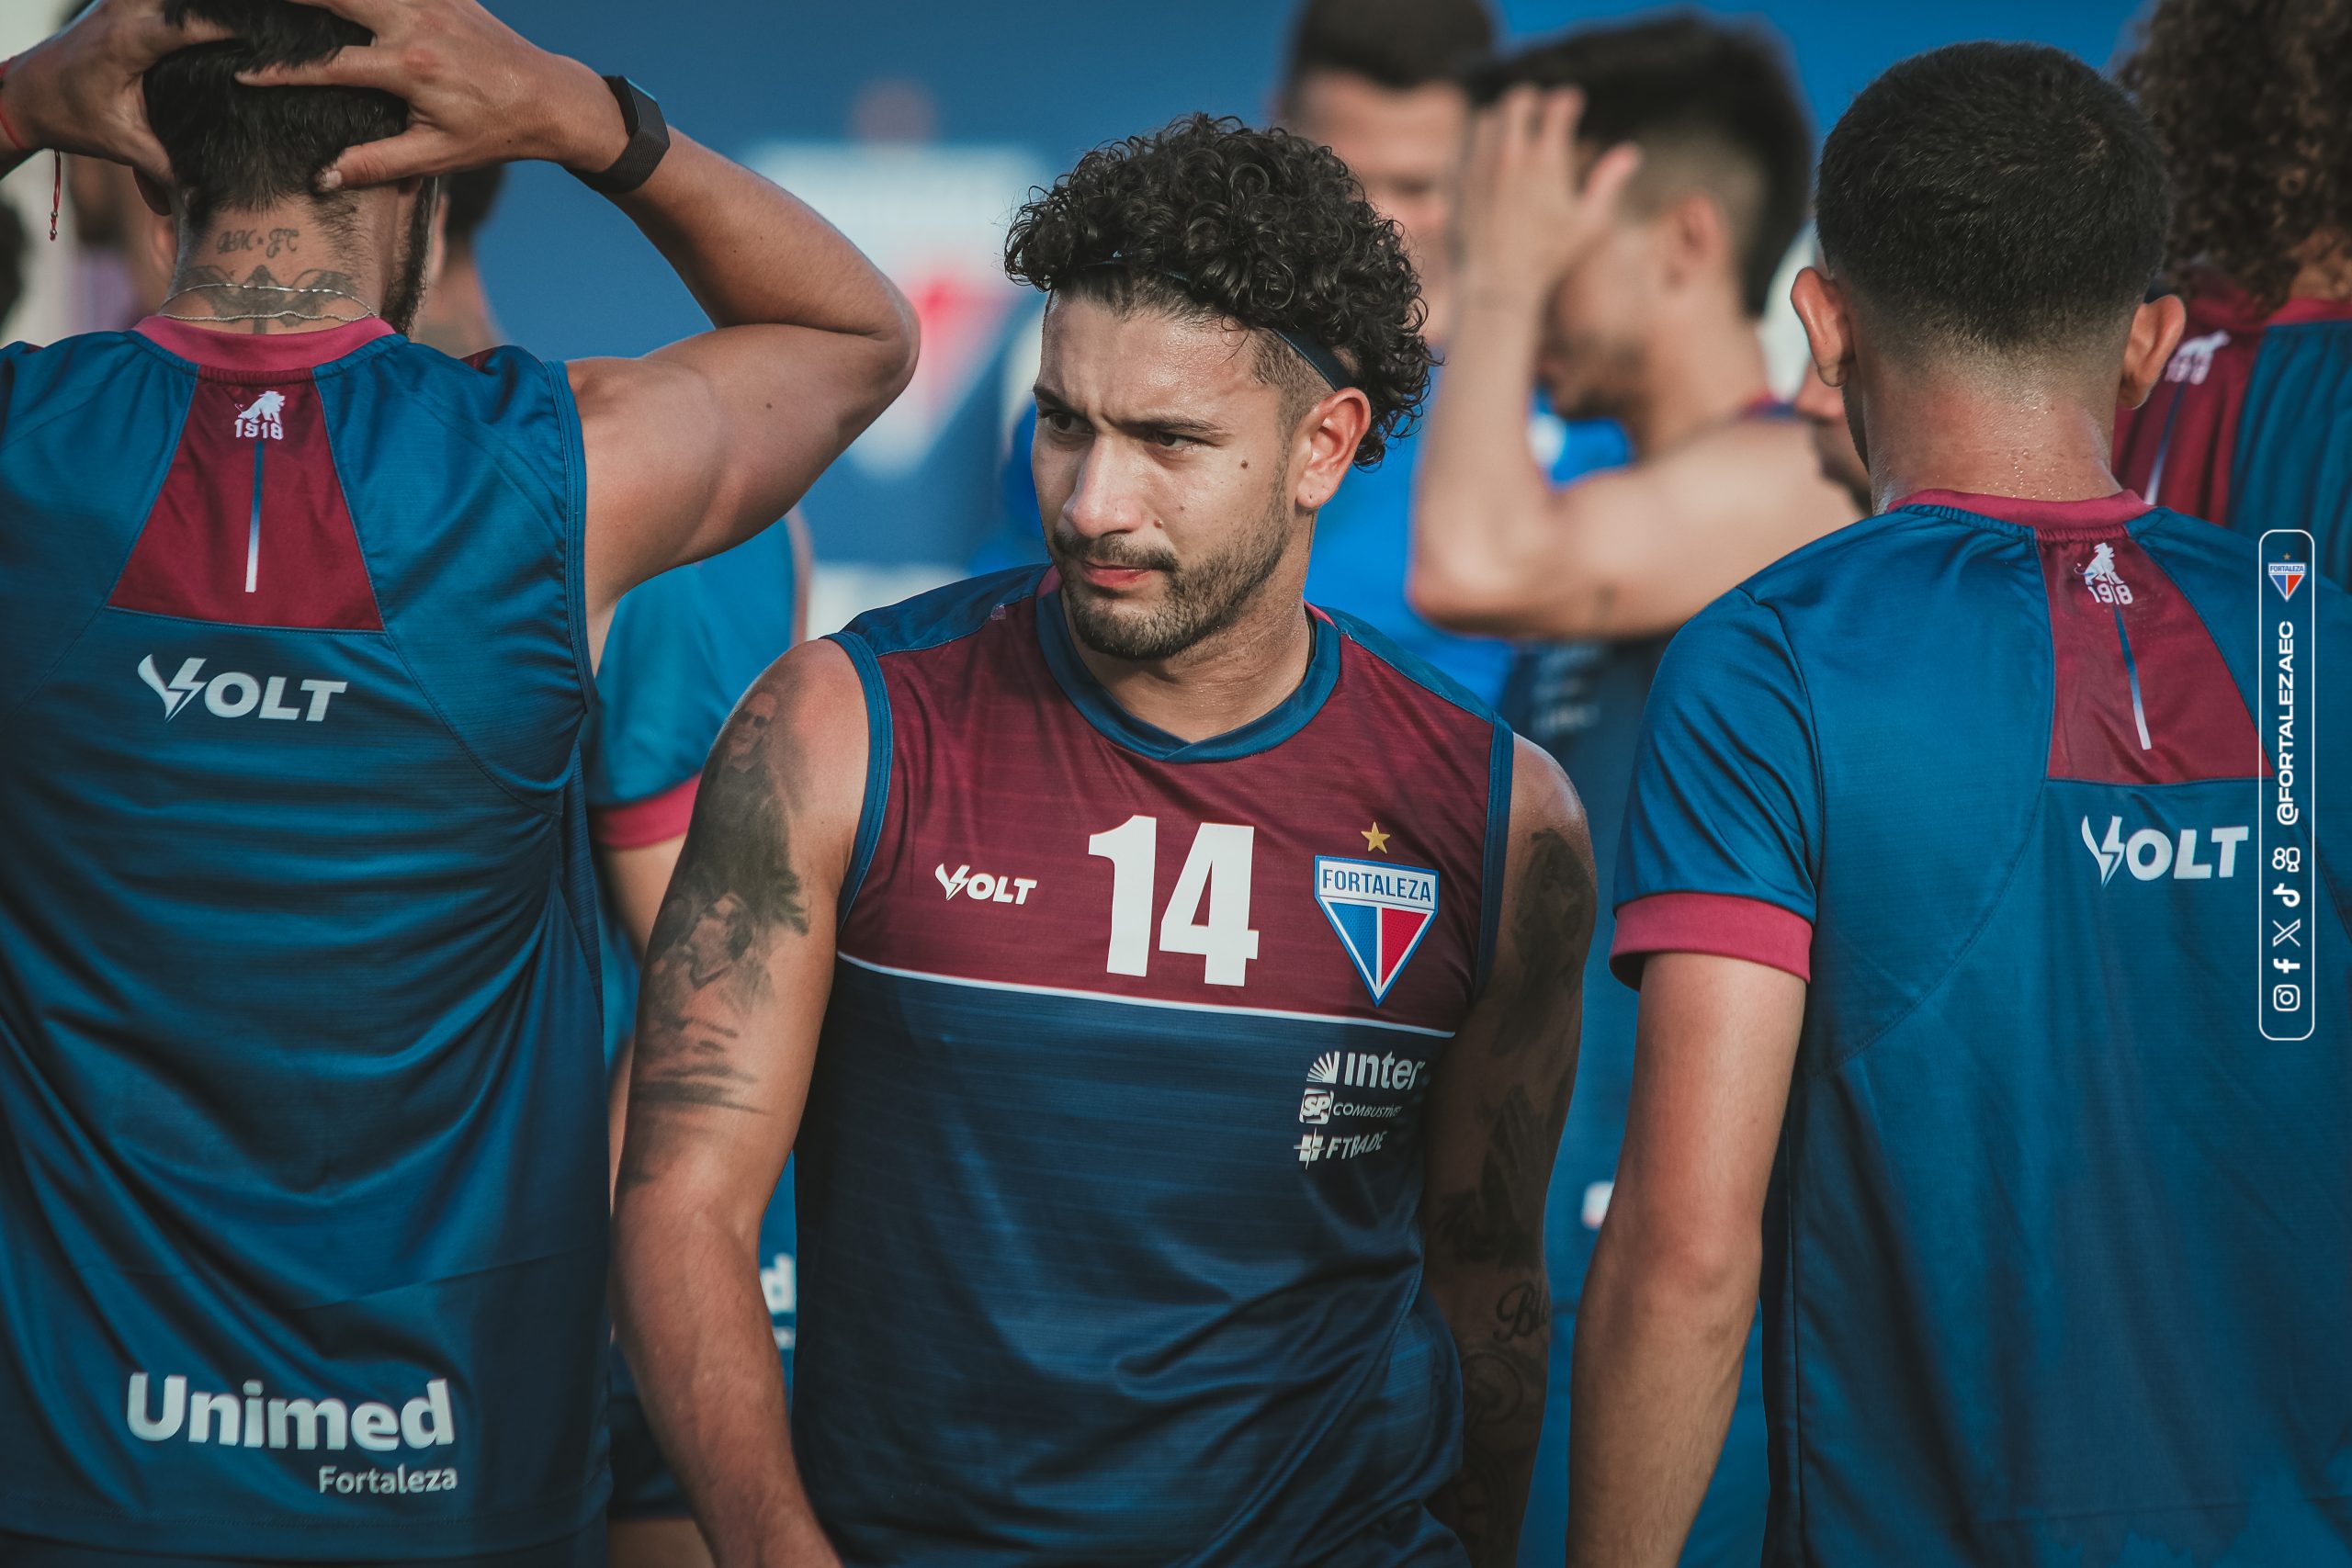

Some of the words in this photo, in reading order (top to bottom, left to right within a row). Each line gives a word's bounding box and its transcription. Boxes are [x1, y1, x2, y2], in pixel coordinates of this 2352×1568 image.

[233, 418, 284, 441] 1918
[2087, 582, 2133, 605] 1918
[137, 653, 348, 724] VOLT
[2081, 815, 2249, 888] VOLT
[934, 863, 1037, 905] VOLT
[1088, 815, 1260, 987] 14
[1322, 868, 1431, 902] FORTALEZA
[1302, 1095, 1331, 1118] SP
[1326, 1131, 1387, 1159] FTRADE
[127, 1372, 455, 1451] Unimed
[319, 1463, 458, 1494] Fortaleza
